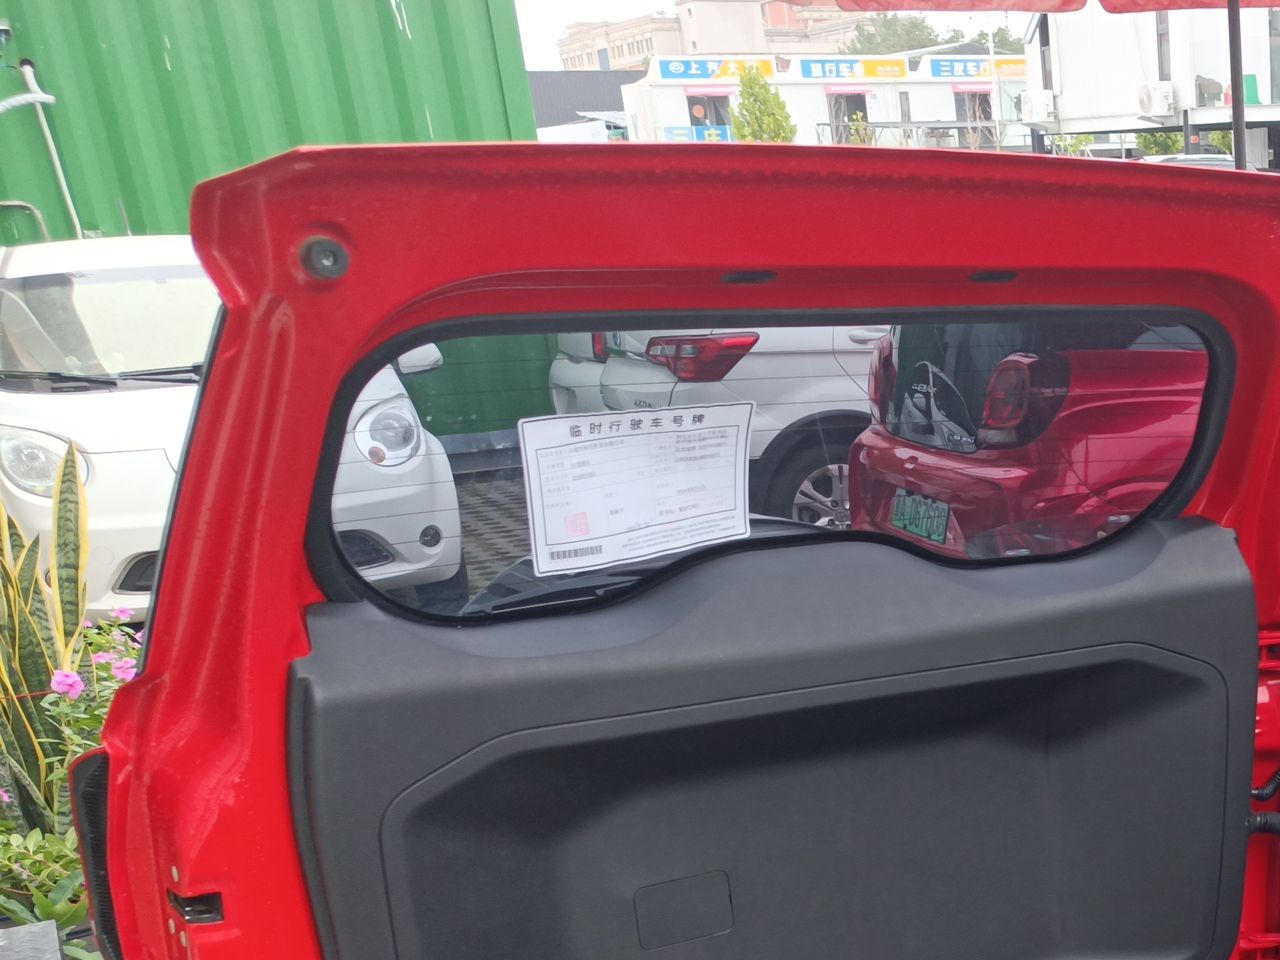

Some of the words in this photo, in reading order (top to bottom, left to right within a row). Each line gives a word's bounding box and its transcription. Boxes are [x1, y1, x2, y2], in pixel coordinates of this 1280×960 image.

[569, 413, 705, 438] 临时行驶车号牌
